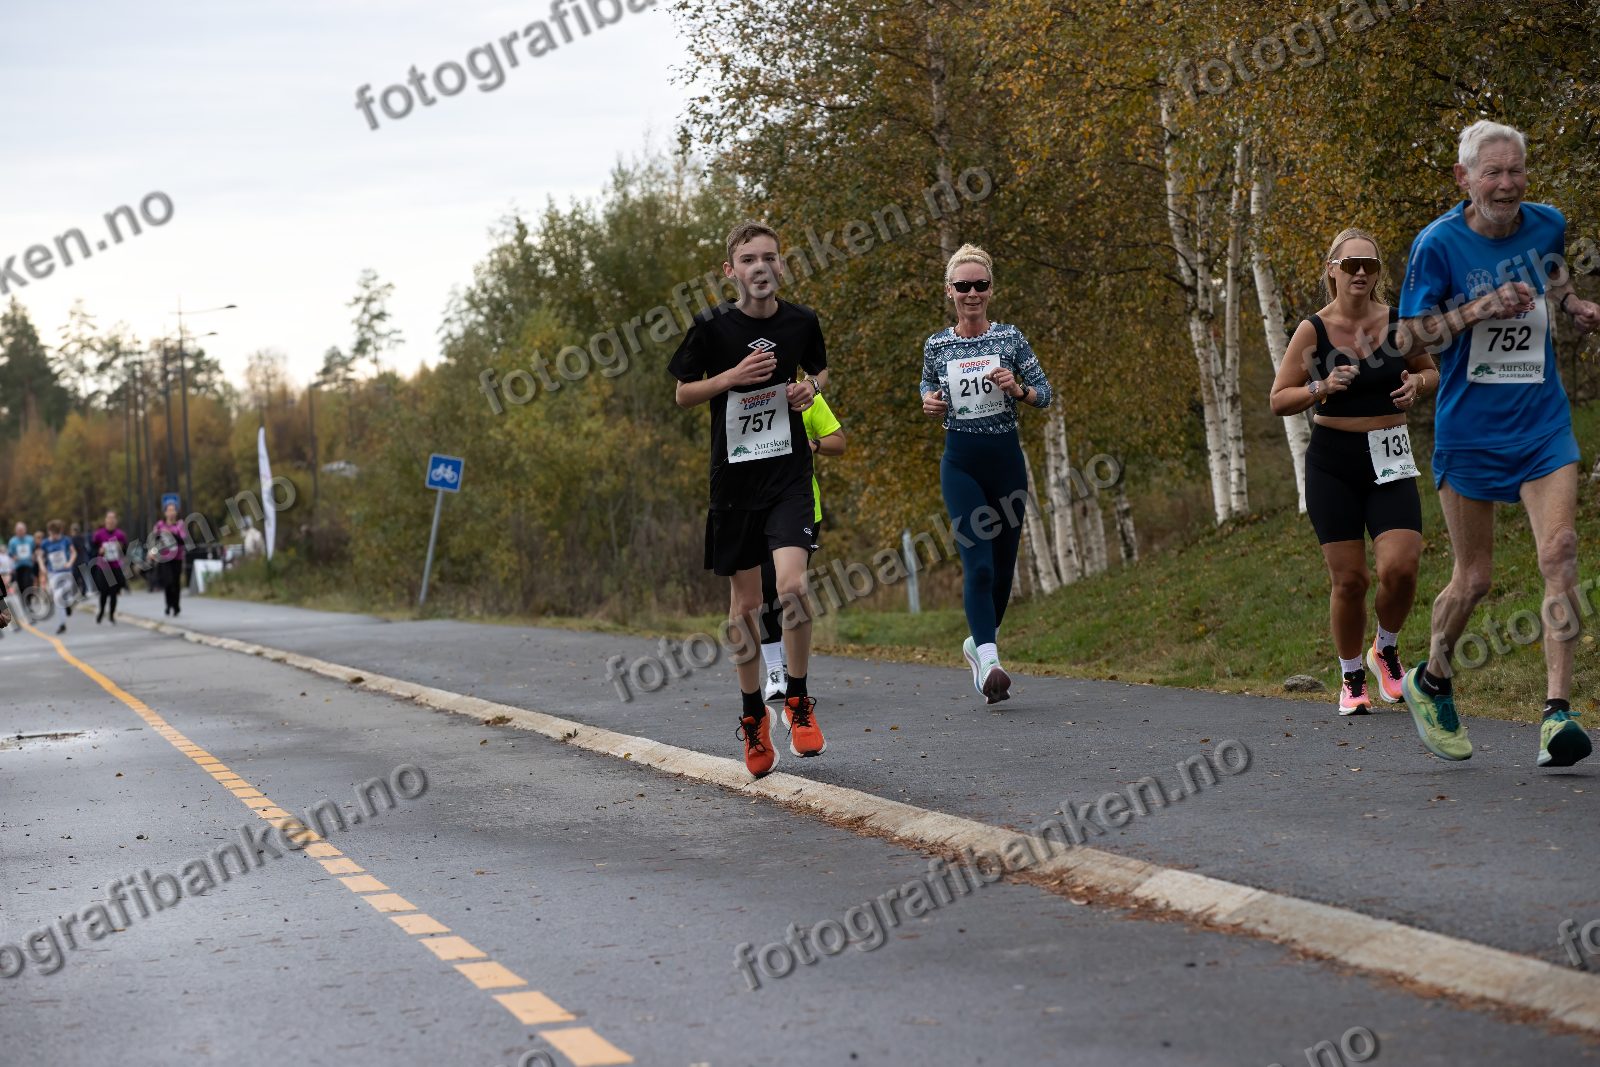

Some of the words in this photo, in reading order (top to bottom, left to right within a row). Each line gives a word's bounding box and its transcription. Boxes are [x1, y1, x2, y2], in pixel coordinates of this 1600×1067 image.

[1487, 325, 1532, 352] 752
[959, 359, 991, 369] NORGES
[1499, 362, 1541, 374] Aurskog
[739, 390, 777, 405] NORGES
[959, 373, 993, 398] 216
[738, 408, 777, 435] 757
[1381, 433, 1410, 457] 133
